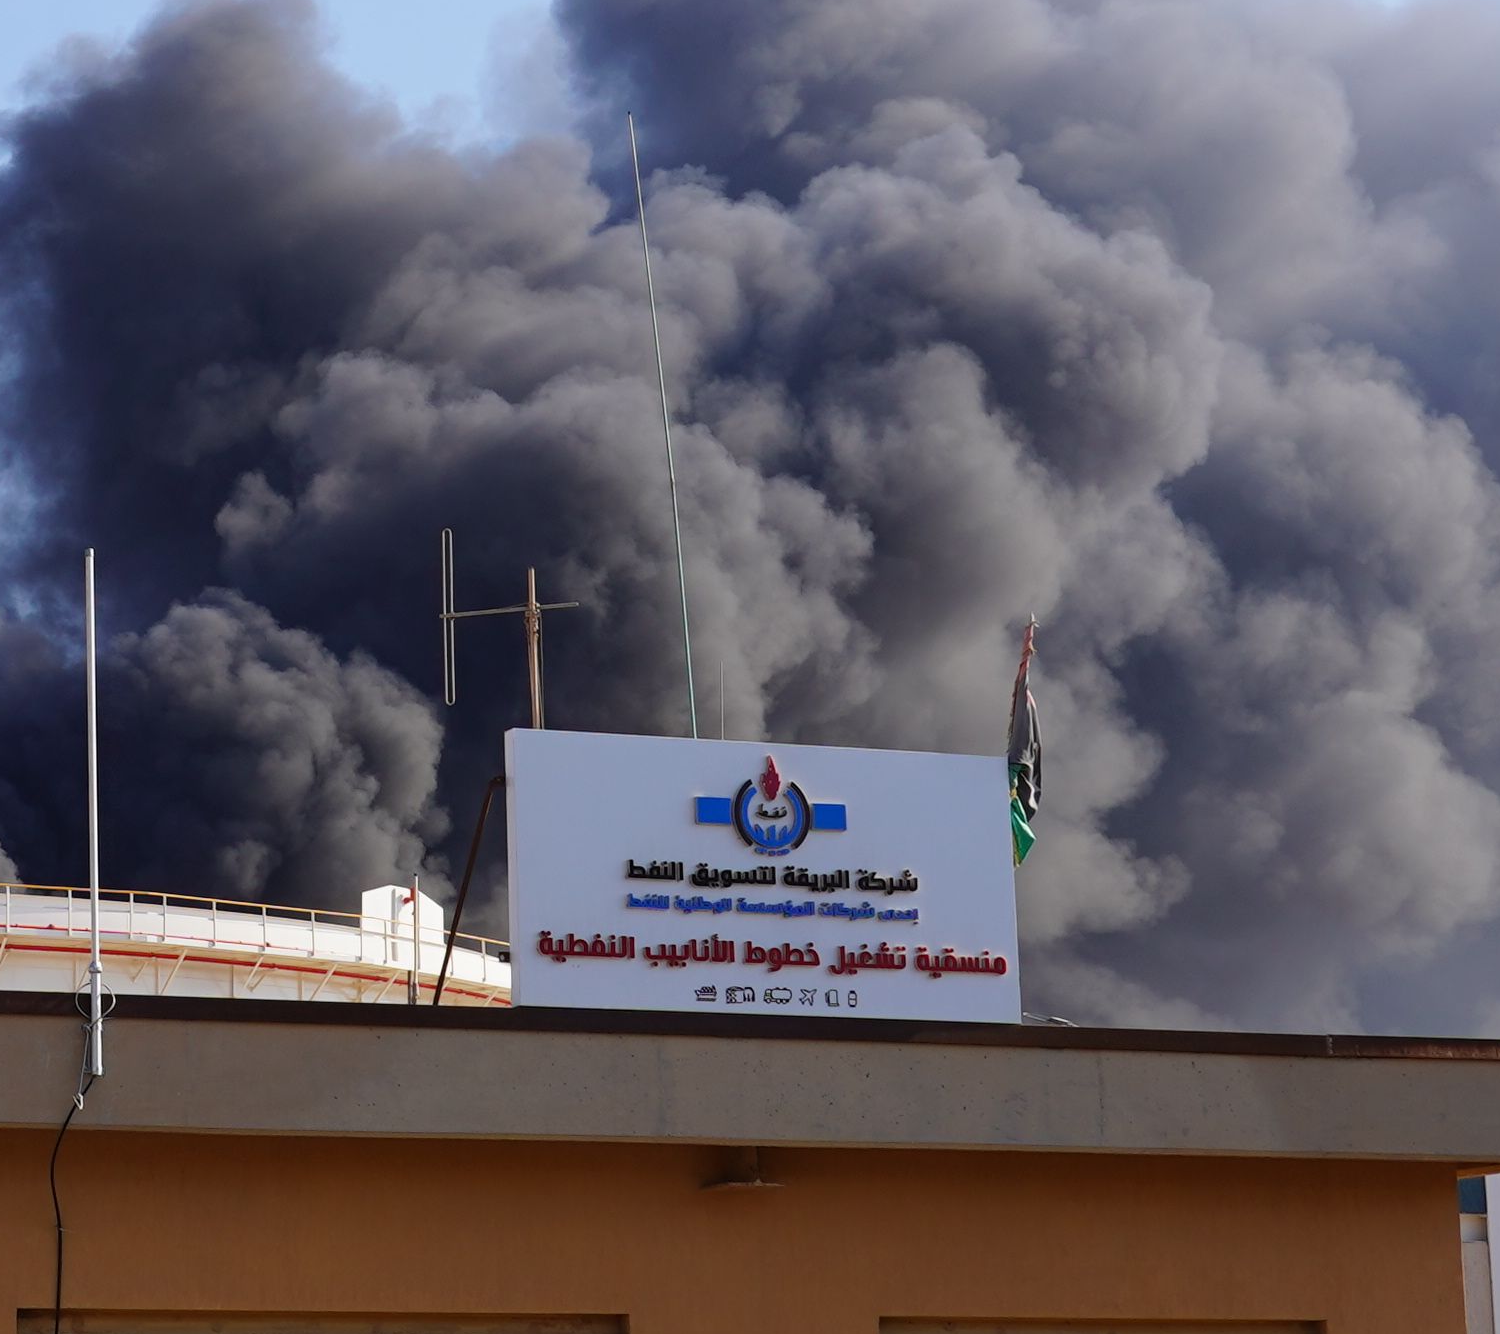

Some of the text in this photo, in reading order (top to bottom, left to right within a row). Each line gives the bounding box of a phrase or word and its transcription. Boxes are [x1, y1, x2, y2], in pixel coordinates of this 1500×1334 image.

[626, 859, 918, 896] شركة البريقة لتسويق النفط
[626, 893, 670, 910] للنفط
[673, 894, 732, 914] الوطنية
[735, 897, 815, 917] المؤسسة
[818, 901, 876, 921] شركات
[536, 930, 1008, 979] منسقية تشغيل خطوط الأنابيب النفطية
